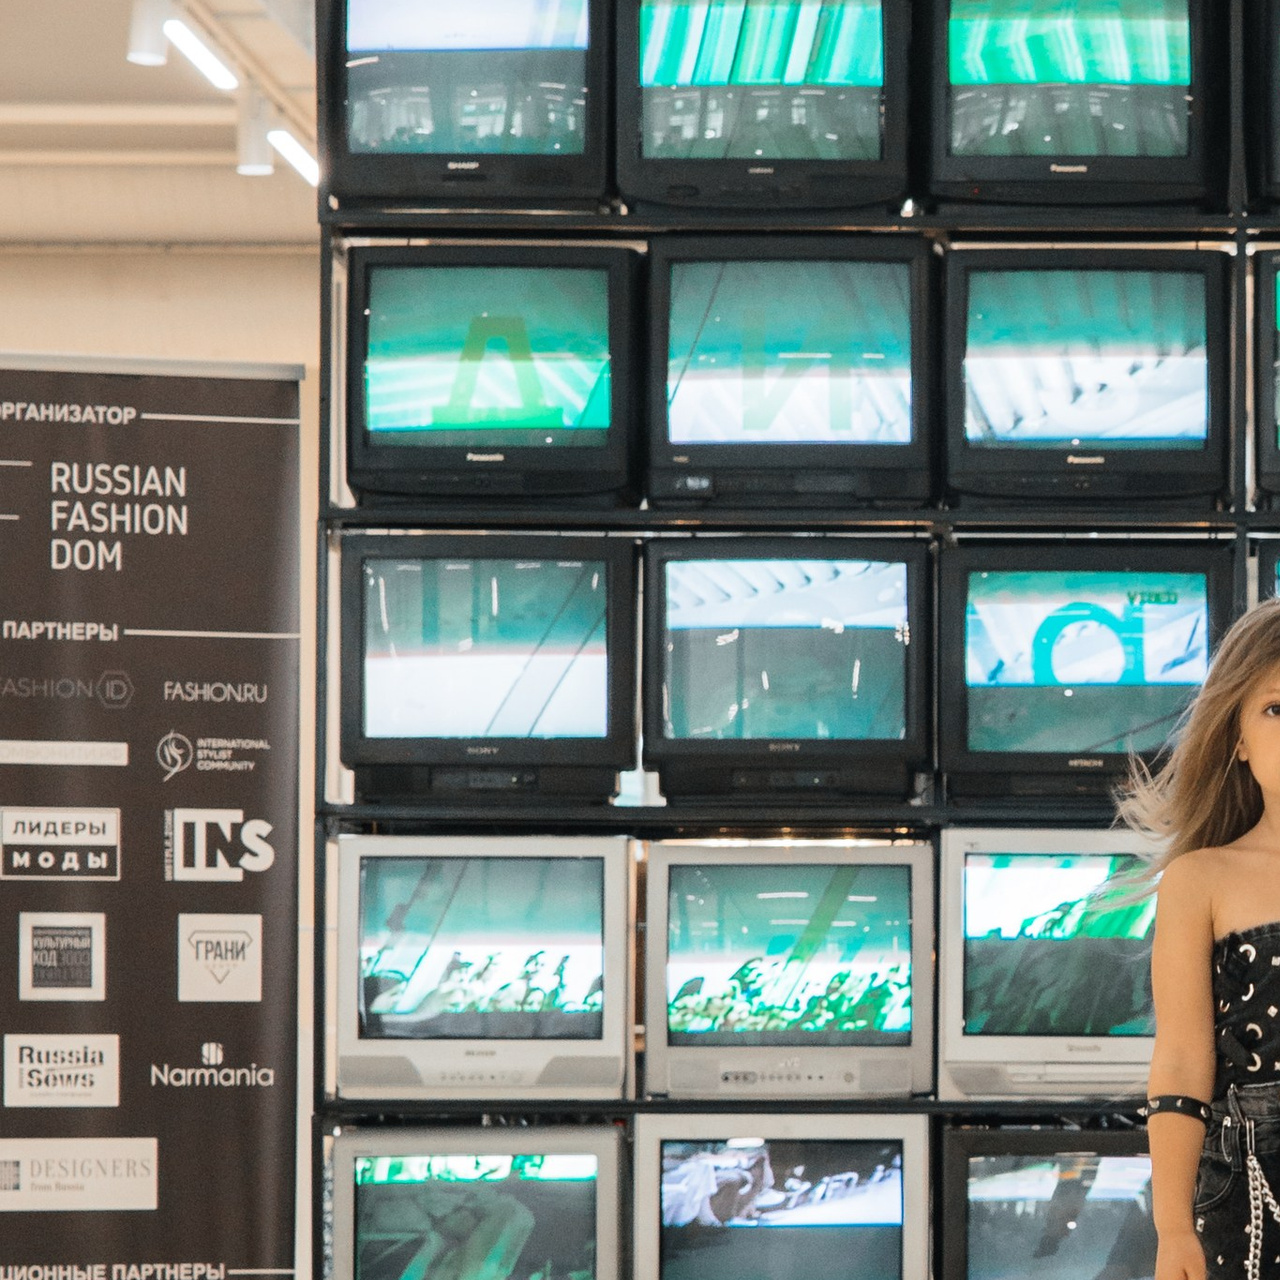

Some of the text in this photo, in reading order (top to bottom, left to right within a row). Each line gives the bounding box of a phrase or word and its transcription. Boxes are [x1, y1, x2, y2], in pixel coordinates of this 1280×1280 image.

[0, 402, 136, 425] РГАНИЗАТОР
[51, 461, 186, 497] RUSSIAN
[51, 500, 187, 535] FASHION
[51, 538, 122, 571] DOM
[2, 620, 119, 642] ПАРТНЕРЫ
[0, 677, 128, 700] ASHION ID
[164, 680, 268, 704] FASHION.RU
[197, 738, 271, 750] INTERNATIONAL
[197, 749, 233, 761] STYLIST
[197, 760, 256, 771] COMMUNITY
[13, 820, 107, 838] ЛИДЕРЫ
[178, 816, 275, 874] INS
[13, 851, 108, 872] МОДЫ
[33, 949, 57, 968] КОД
[195, 940, 246, 961] ГРАНИ
[19, 1045, 104, 1065] Russia
[151, 1063, 274, 1087] Narmania
[30, 1158, 150, 1179] DESIGNERS
